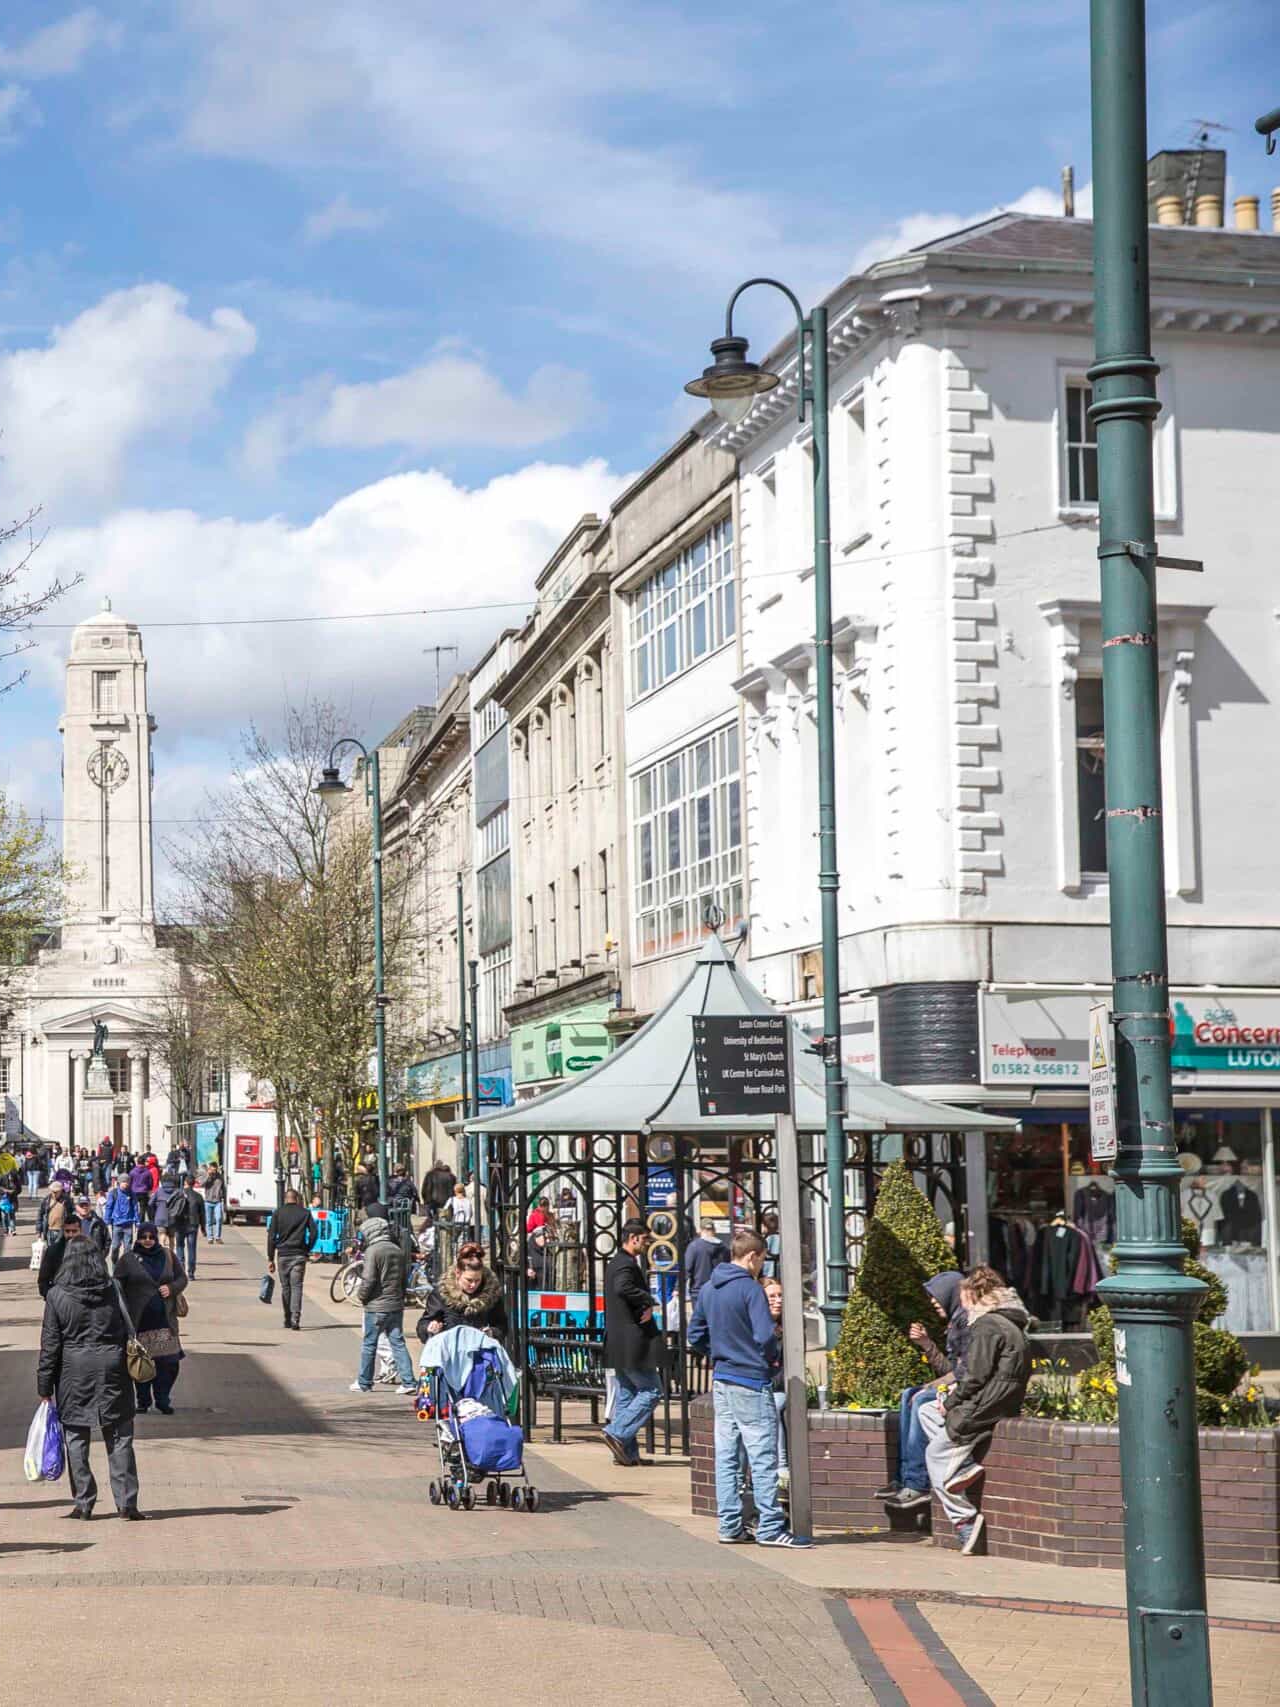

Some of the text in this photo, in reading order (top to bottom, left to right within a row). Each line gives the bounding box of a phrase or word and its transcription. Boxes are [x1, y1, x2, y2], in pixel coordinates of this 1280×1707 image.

[723, 1036, 747, 1047] University
[748, 1036, 754, 1045] of
[992, 1043, 1057, 1058] Telephone
[744, 1051, 784, 1063] St Mary's Church
[992, 1063, 1080, 1075] 01582 456812
